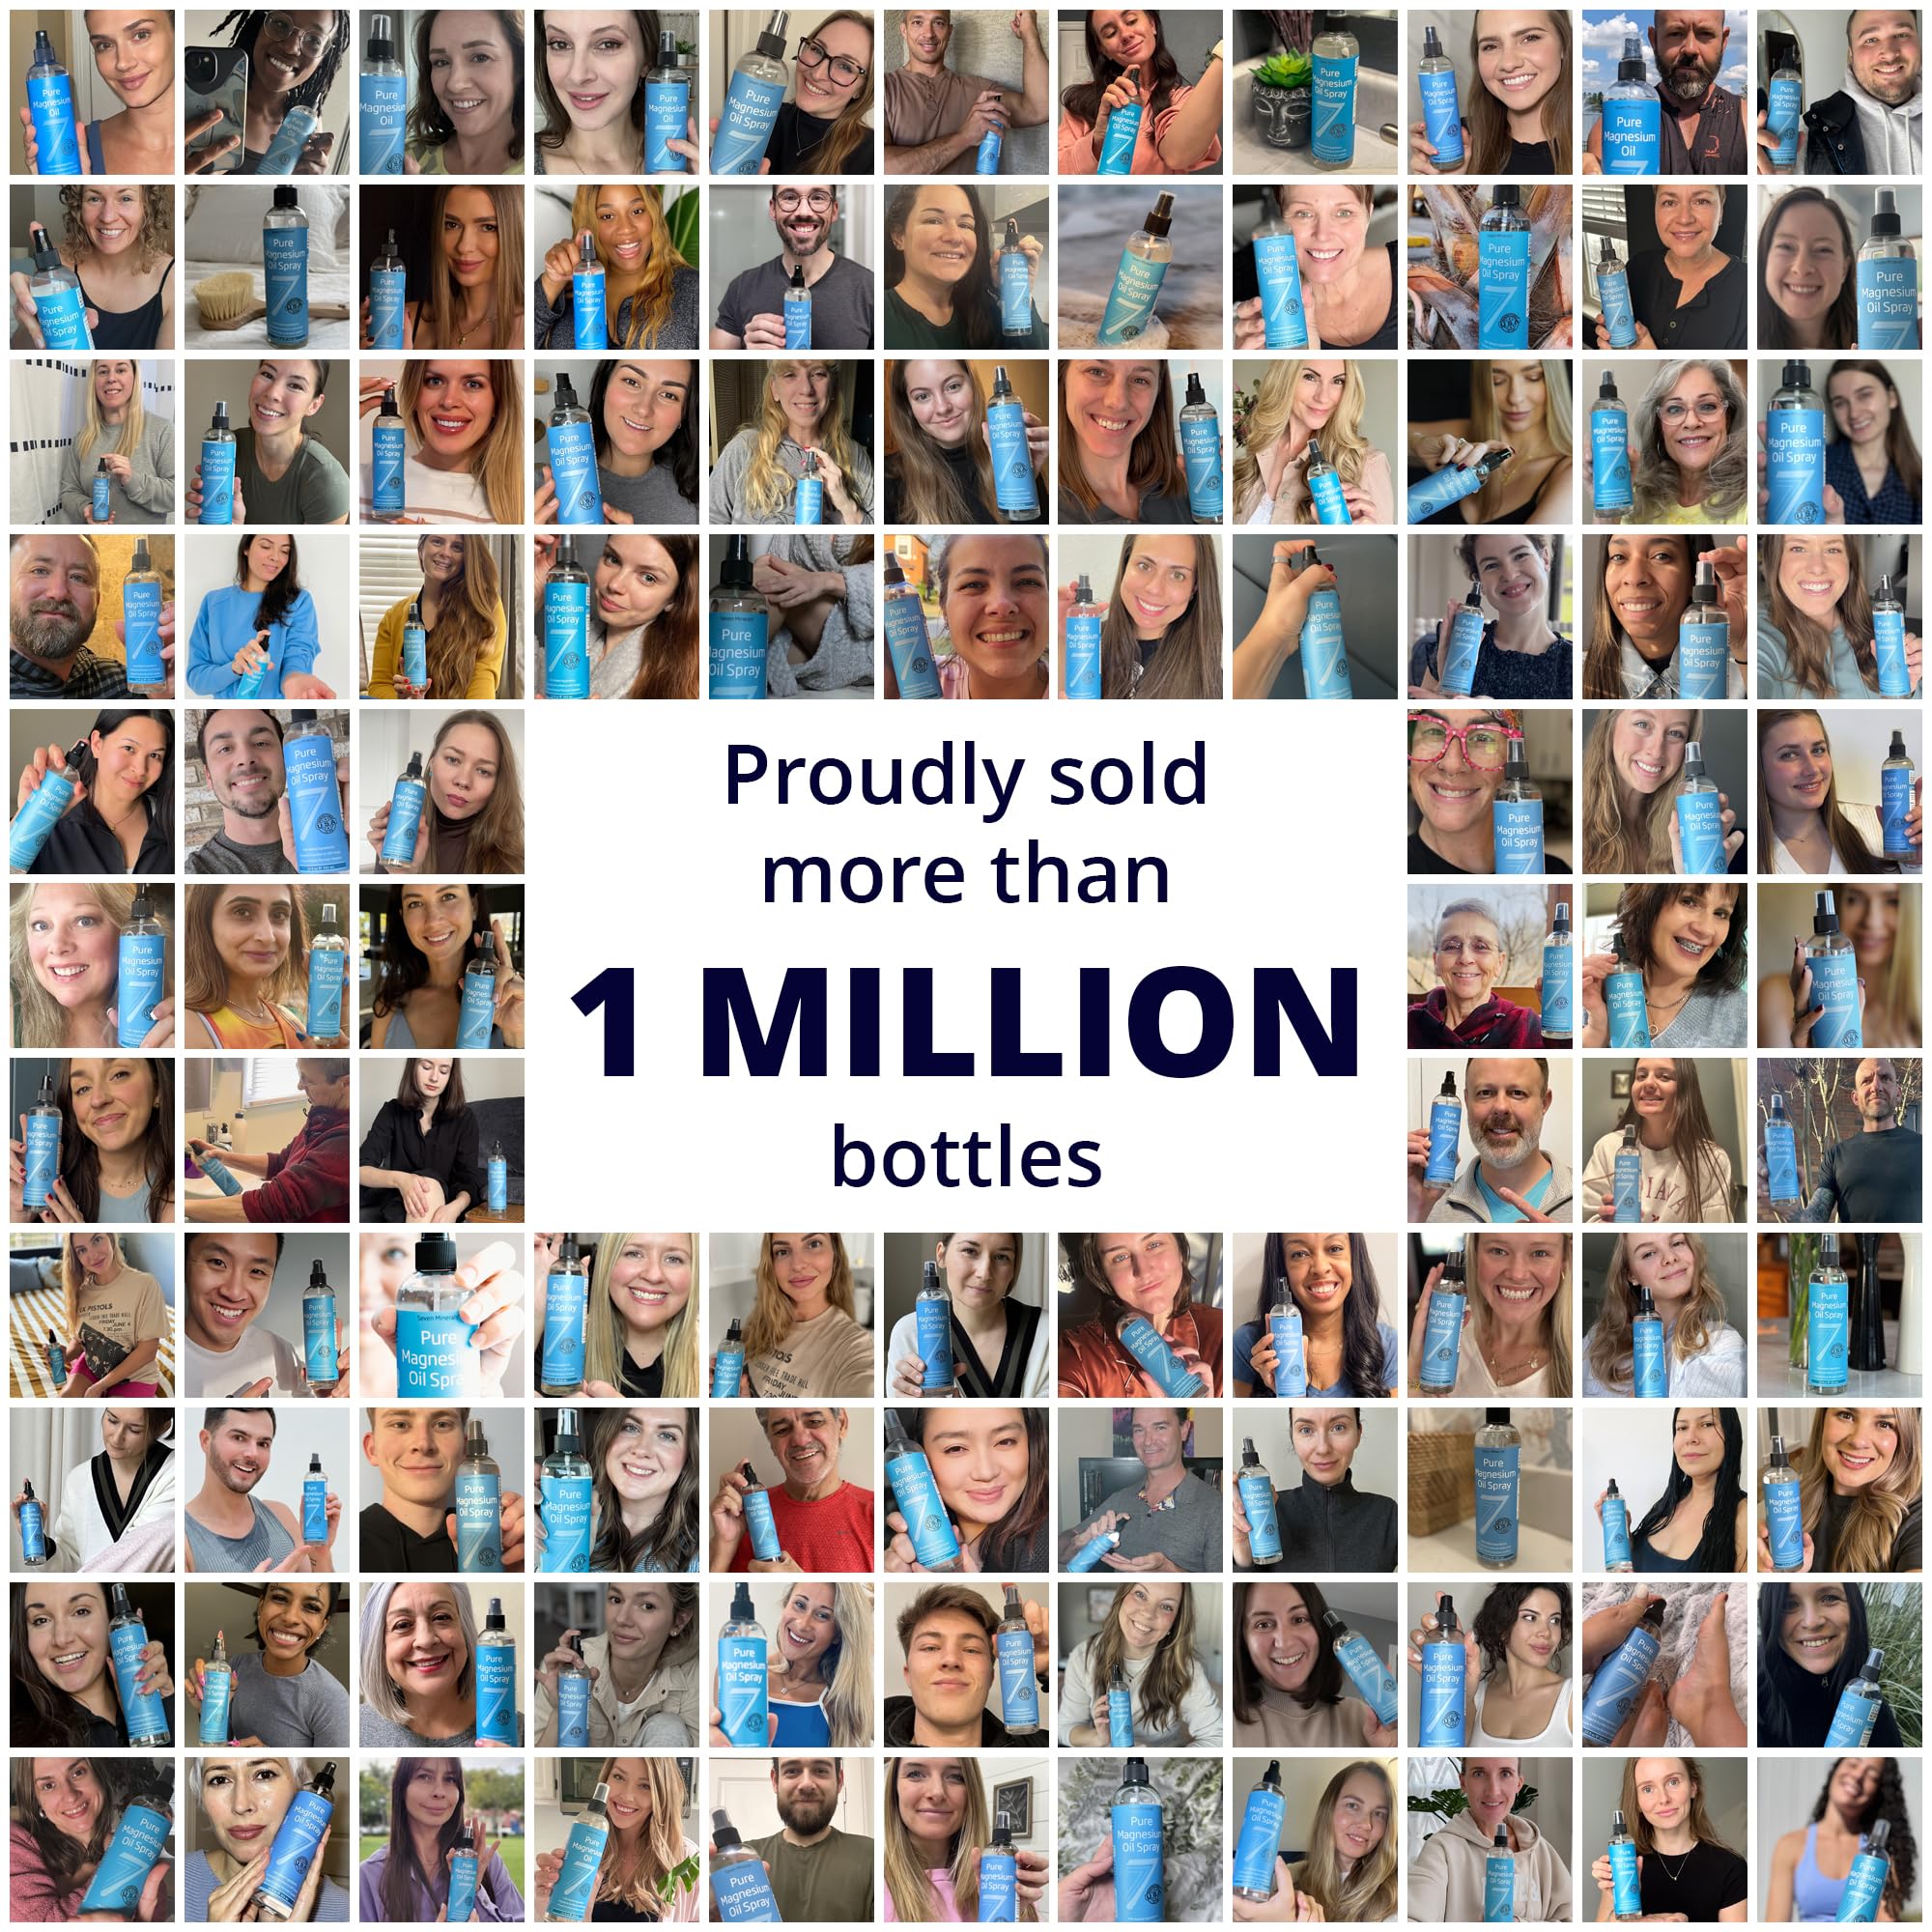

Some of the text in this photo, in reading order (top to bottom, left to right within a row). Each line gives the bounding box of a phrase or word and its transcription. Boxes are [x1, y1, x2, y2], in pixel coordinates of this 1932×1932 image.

[1321, 68, 1340, 77] Pure
[375, 91, 397, 99] Pure
[746, 90, 770, 104] Pure
[1324, 88, 1347, 99] Spray
[49, 108, 60, 117] Oil
[380, 116, 392, 125] Oil
[729, 113, 769, 131] Oil Spray
[1617, 117, 1641, 128] Pure
[1605, 131, 1655, 144] Magnesium
[1621, 146, 1635, 156] Oil
[1489, 243, 1511, 253] Pure
[268, 261, 301, 271] Oil Spray
[1480, 256, 1524, 268] Magnesium
[1130, 265, 1150, 277] Pure
[1274, 265, 1293, 274] Spray
[1482, 269, 1519, 280] Oil Spray
[1119, 270, 1159, 290] Magnesium
[1877, 272, 1902, 281] Pure
[1118, 283, 1151, 301] Oil Spray
[1862, 287, 1916, 299] Magnesium
[1867, 302, 1913, 315] Oil Spray
[1781, 423, 1806, 433] Pure
[559, 434, 579, 442] Pure
[551, 442, 591, 455] Magnesium
[1769, 439, 1821, 450] Magnesium
[555, 455, 588, 466] Oil Spray
[1773, 452, 1816, 464] Oil Spray
[554, 593, 572, 602] Pure
[556, 615, 580, 624] Spray
[722, 629, 752, 640] Pure
[1690, 635, 1712, 643] Pure
[1684, 658, 1719, 668] Oil Spray
[709, 664, 759, 679] Oil Spray
[295, 748, 316, 758] Pure
[287, 759, 331, 774] Magnesium
[292, 770, 328, 784] Oil Spray
[1509, 813, 1530, 823] Pure
[1496, 826, 1542, 836] Magnesium
[1502, 838, 1538, 849] Oil Spray
[122, 956, 162, 968] Magnesium
[126, 967, 158, 978] Oil Spray
[1825, 966, 1845, 976] Pure
[1818, 991, 1854, 1003] Oil Spray
[1812, 1301, 1847, 1312] Magnesium
[1825, 1311, 1843, 1321] Spray
[421, 1330, 456, 1345] Pure
[410, 1371, 464, 1391] Oil Spra
[762, 1375, 787, 1390] FRIDAY
[1484, 1459, 1503, 1467] Pure
[465, 1485, 484, 1493] Pure
[1489, 1481, 1512, 1492] Spray
[559, 1491, 582, 1499] Pure
[456, 1496, 497, 1506] Magnesium
[469, 1508, 493, 1518] Spray
[551, 1514, 586, 1525] Oil Spray
[733, 1648, 754, 1657] Pure
[1435, 1653, 1453, 1662] Pure
[477, 1664, 513, 1674] Magnesium
[722, 1661, 765, 1672] Magnesium
[1423, 1663, 1463, 1674] Magnesium
[490, 1675, 510, 1685] Spray
[726, 1672, 762, 1683] Oil Spray
[1426, 1674, 1460, 1684] Oil Spray
[309, 1801, 326, 1814] Pure
[140, 1818, 159, 1833] Pure
[294, 1816, 322, 1835] Oil Spray
[1131, 1817, 1152, 1827] Pure
[123, 1825, 162, 1849] Magnesium
[122, 1835, 156, 1859] Oil Spray
[1122, 1842, 1160, 1854] Oil Spray
[730, 1874, 754, 1886] Pure
[721, 1885, 769, 1906] Magnesium
[728, 1897, 770, 1918] Oil Spray
